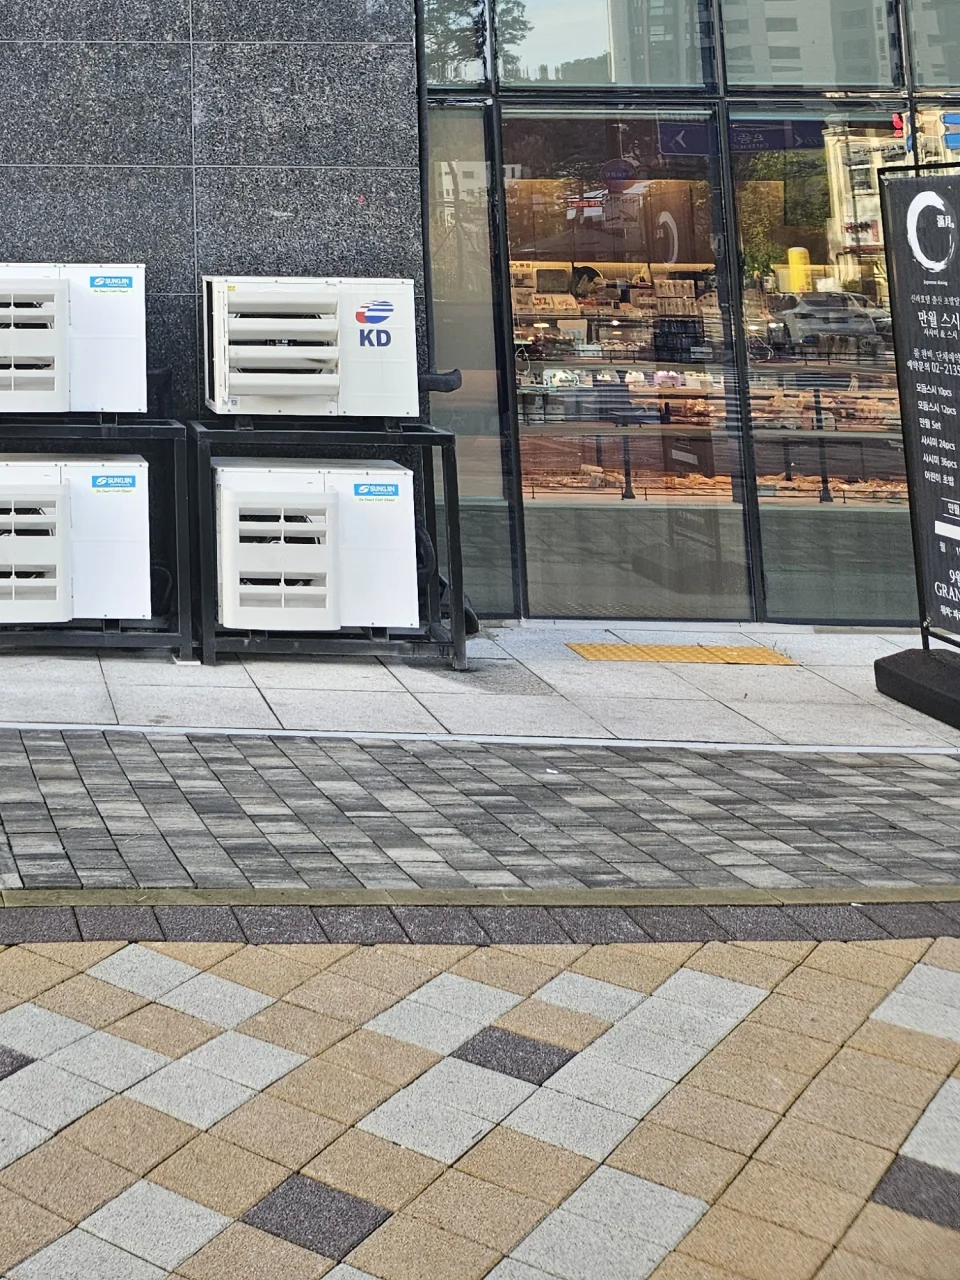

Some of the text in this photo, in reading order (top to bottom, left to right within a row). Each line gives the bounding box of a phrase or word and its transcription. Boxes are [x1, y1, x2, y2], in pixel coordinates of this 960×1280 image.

[918, 310, 960, 331] 만월 스시
[359, 329, 392, 347] KD
[923, 328, 939, 338] 사시미
[947, 330, 958, 340] 스시
[906, 360, 931, 373] 예약문의
[937, 387, 952, 397] 10pcs
[941, 405, 956, 415] 12pcs
[931, 420, 942, 430] Set
[921, 435, 956, 451] 사시미 24pcs
[923, 453, 957, 469] 사시미 36pcs
[942, 475, 955, 487] 초밥
